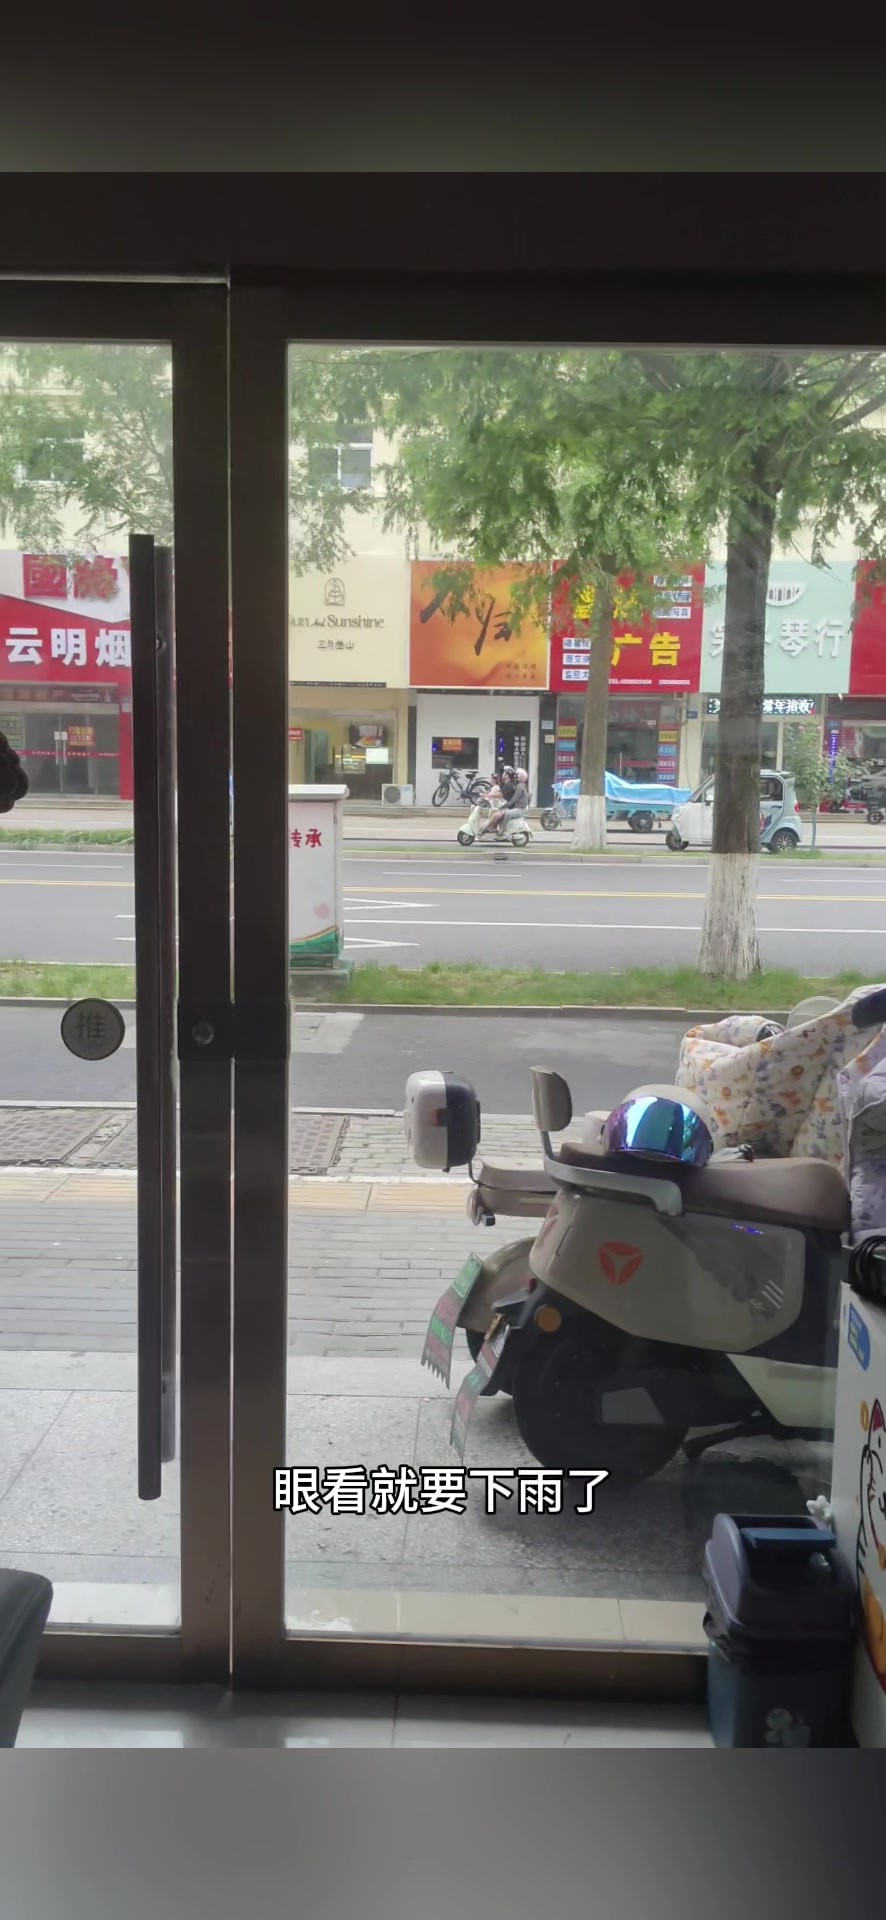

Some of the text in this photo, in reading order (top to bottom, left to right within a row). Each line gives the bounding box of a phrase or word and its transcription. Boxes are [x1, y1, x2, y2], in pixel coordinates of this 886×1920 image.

[327, 614, 384, 628] Sunshine
[5, 627, 131, 667] 云明烟
[611, 632, 681, 666] 广告
[75, 1010, 106, 1040] 推
